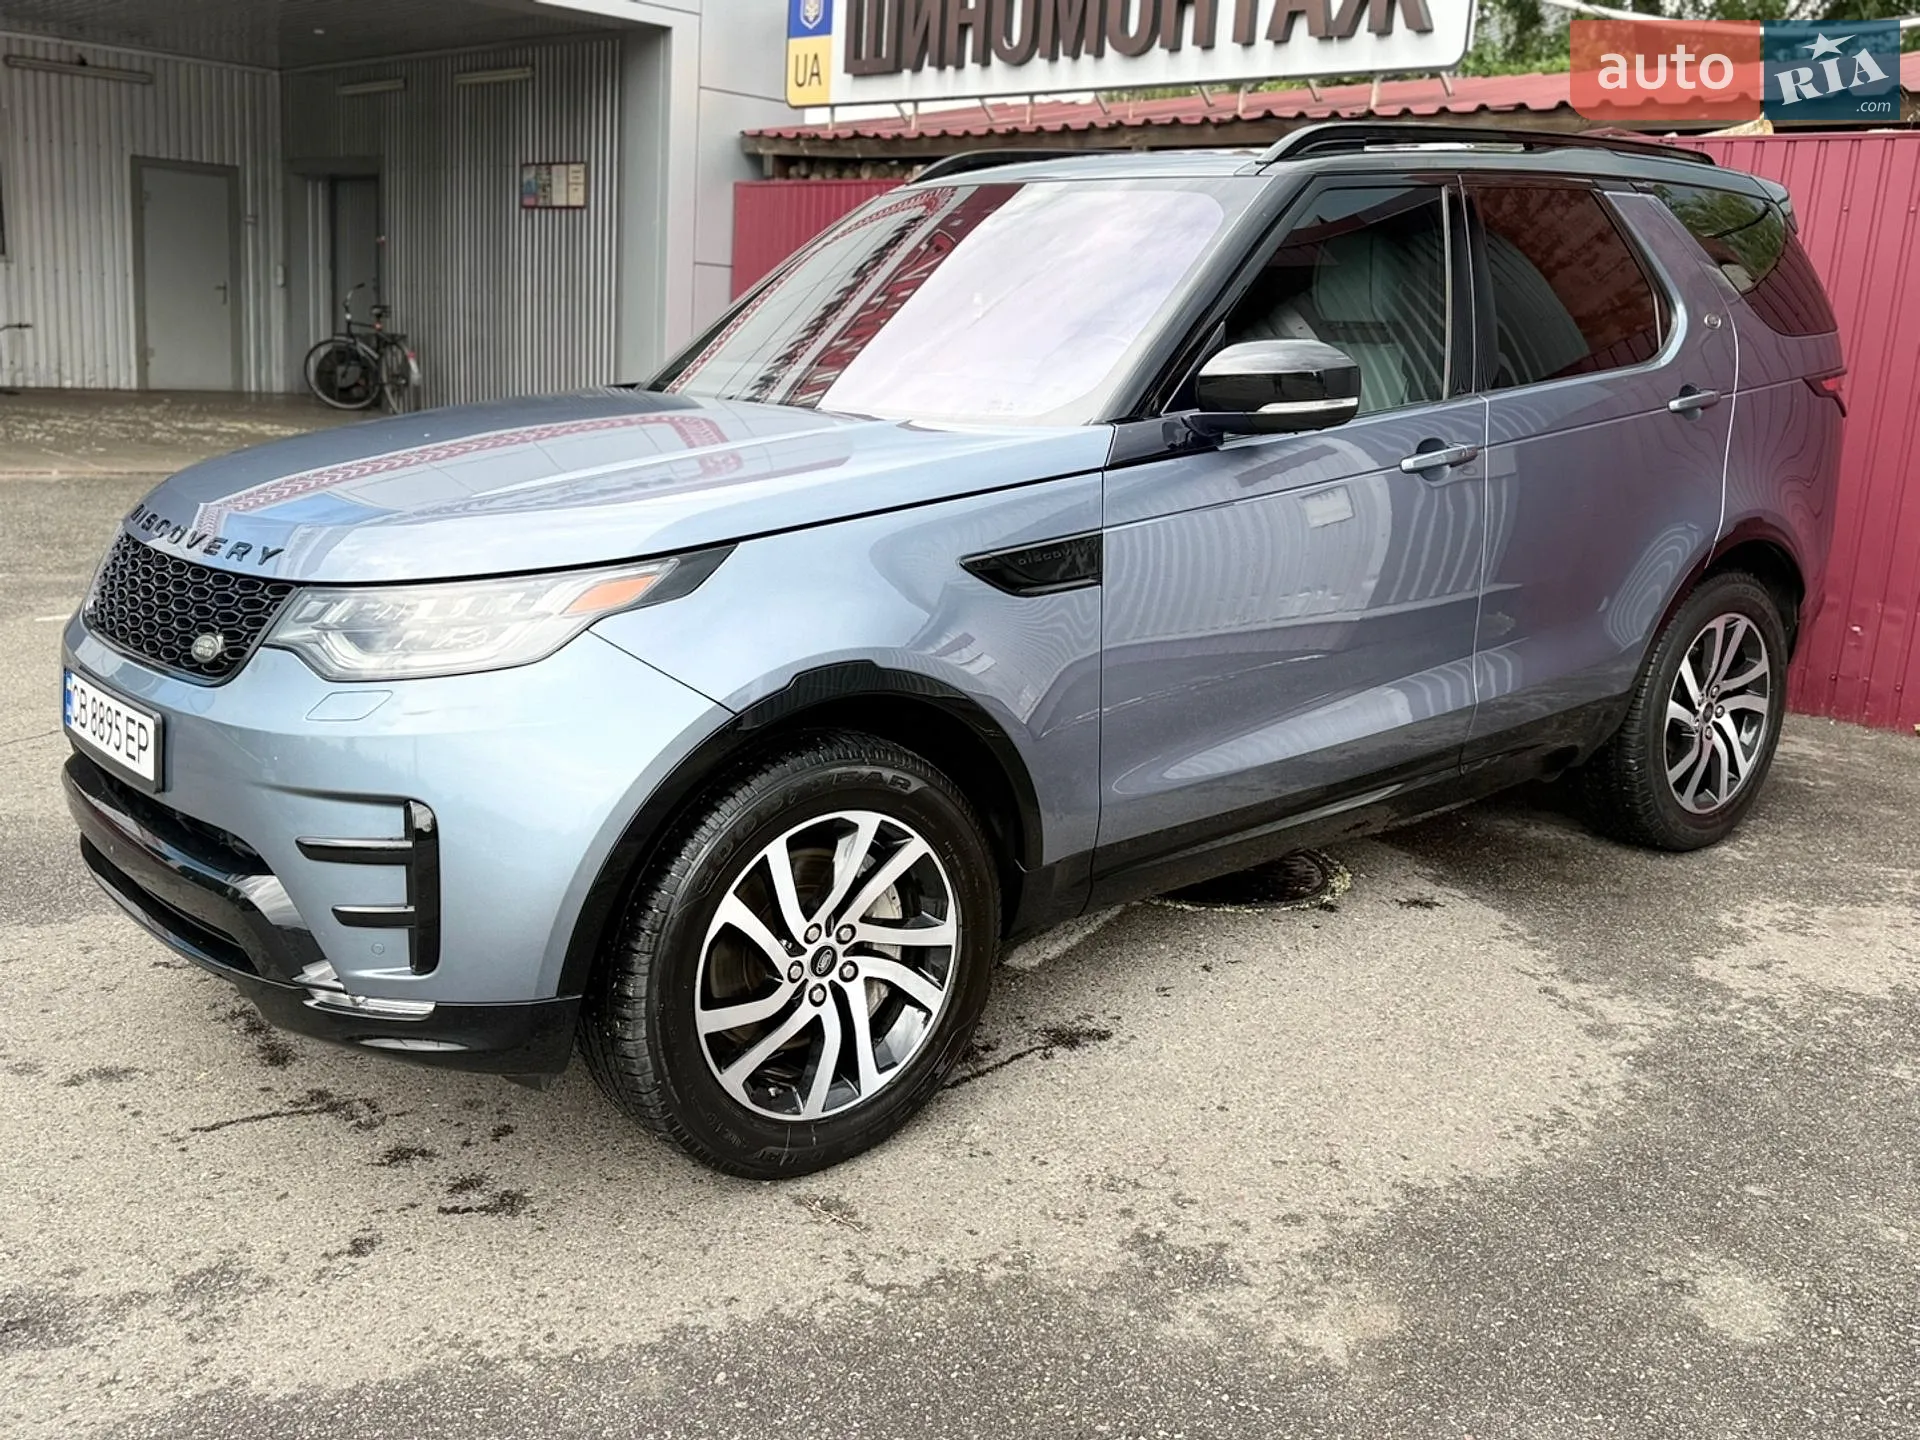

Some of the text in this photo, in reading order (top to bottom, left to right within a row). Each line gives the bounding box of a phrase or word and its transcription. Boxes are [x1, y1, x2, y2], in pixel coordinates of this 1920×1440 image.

[795, 53, 822, 88] UA
[131, 503, 285, 566] DISCOVERY
[73, 684, 150, 764] CB 8895 EP
